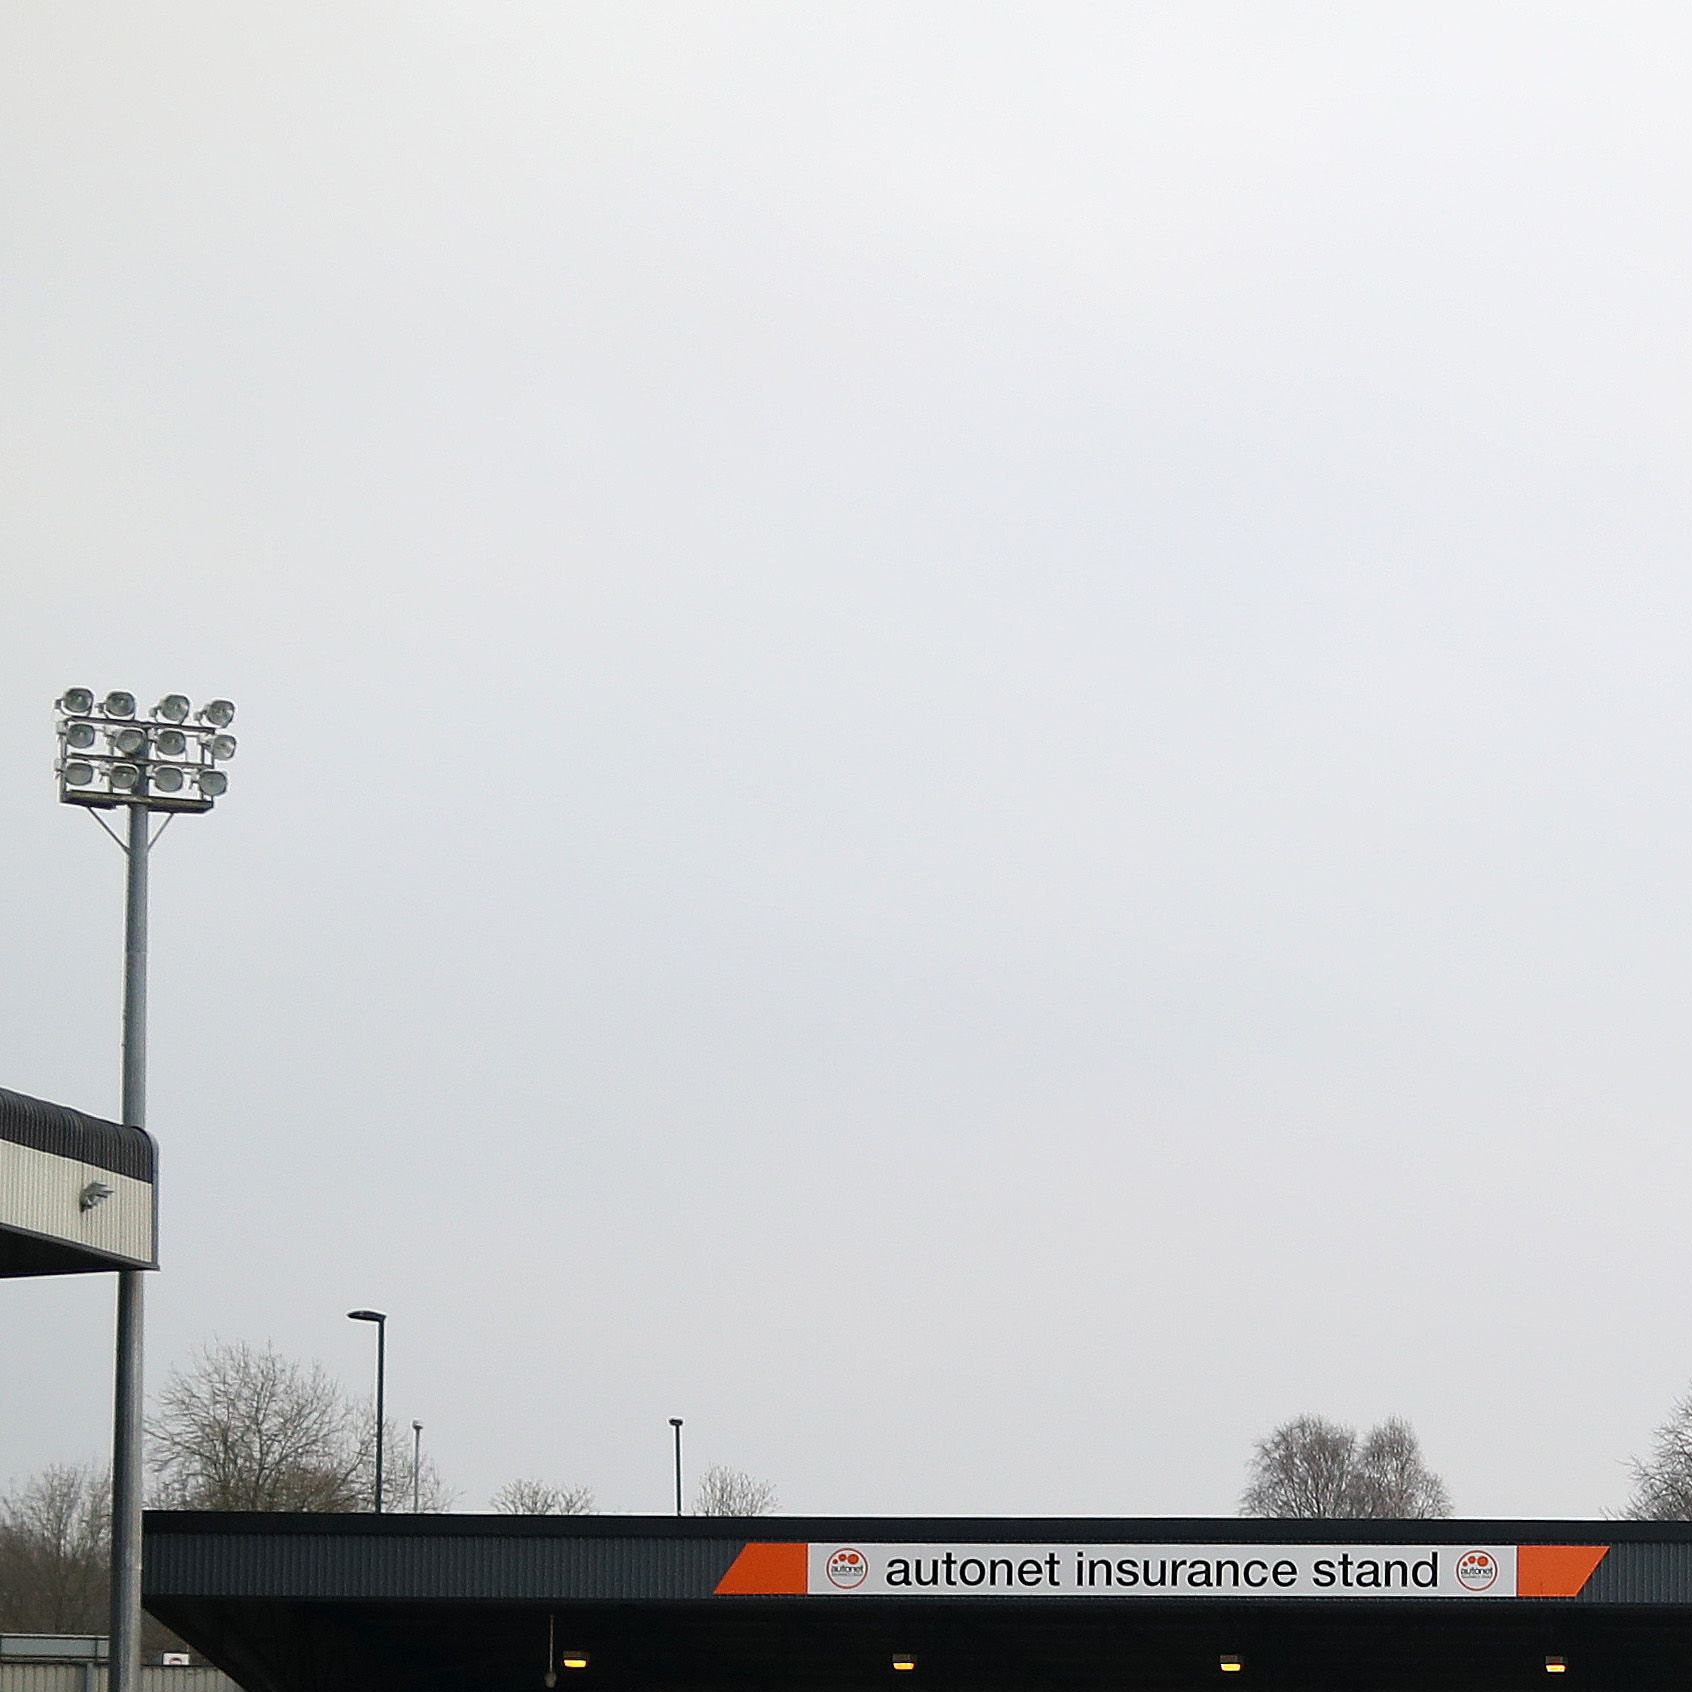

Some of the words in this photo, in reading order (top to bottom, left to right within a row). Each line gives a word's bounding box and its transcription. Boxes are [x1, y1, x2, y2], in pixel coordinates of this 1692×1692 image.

[886, 1552, 1060, 1587] autonet
[1076, 1551, 1297, 1587] insurance
[1312, 1551, 1438, 1588] stand
